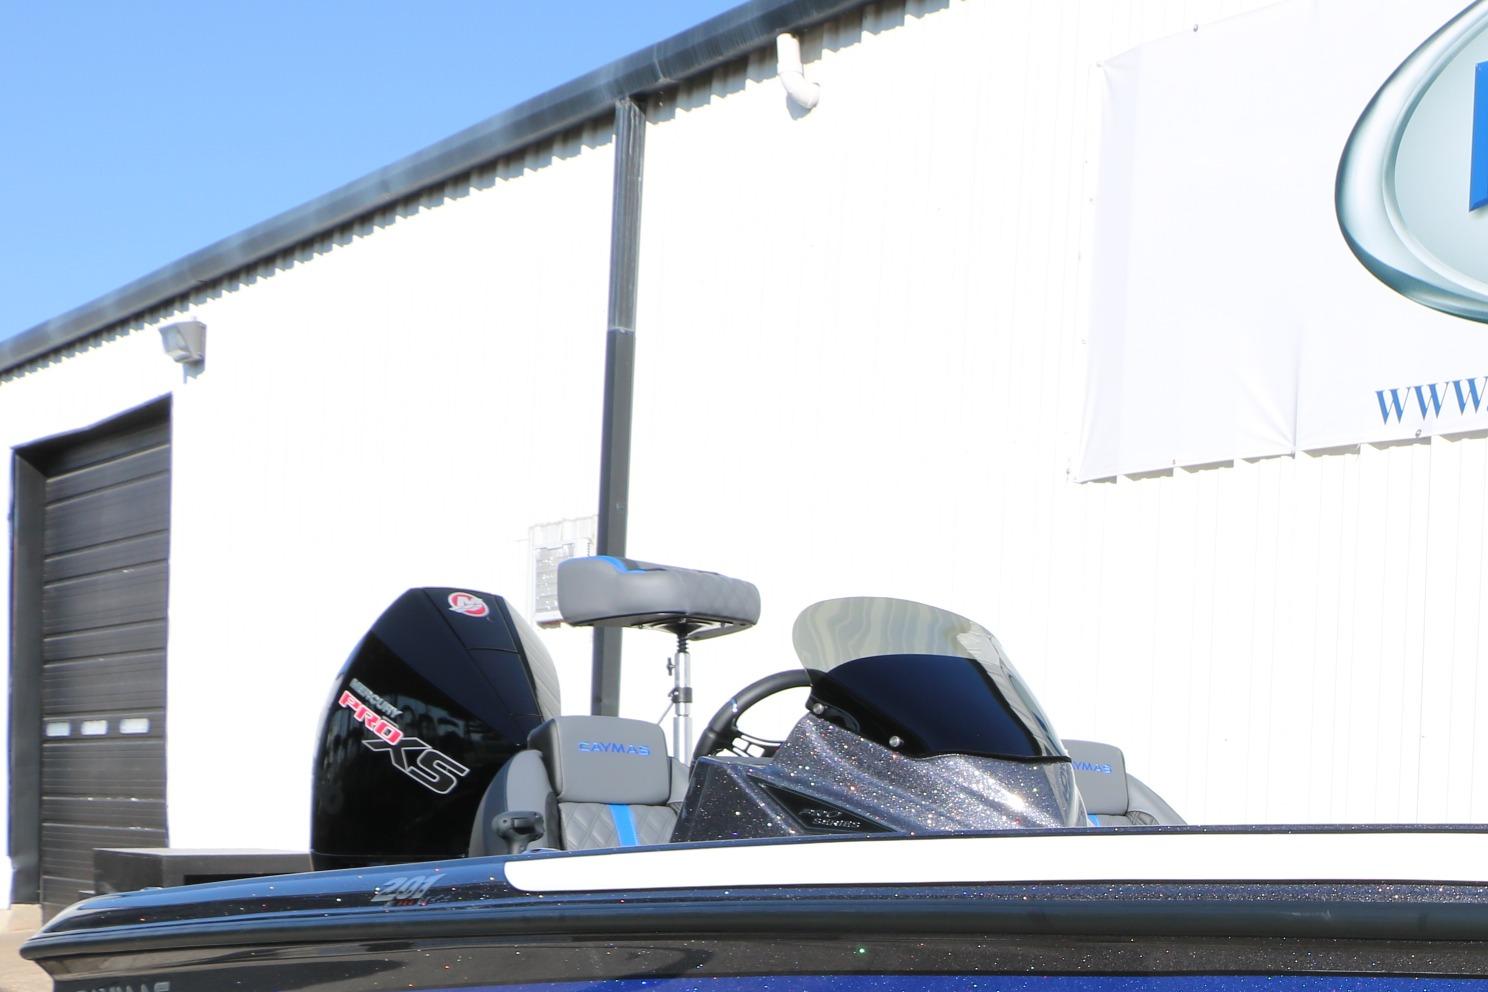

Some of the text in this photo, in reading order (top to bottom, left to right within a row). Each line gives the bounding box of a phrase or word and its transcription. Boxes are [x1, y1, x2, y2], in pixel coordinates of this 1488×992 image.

[339, 690, 403, 745] PRO
[349, 678, 403, 718] MERCURY
[361, 737, 470, 794] XS
[578, 741, 651, 756] CAYMAS
[1072, 760, 1112, 775] YMAS
